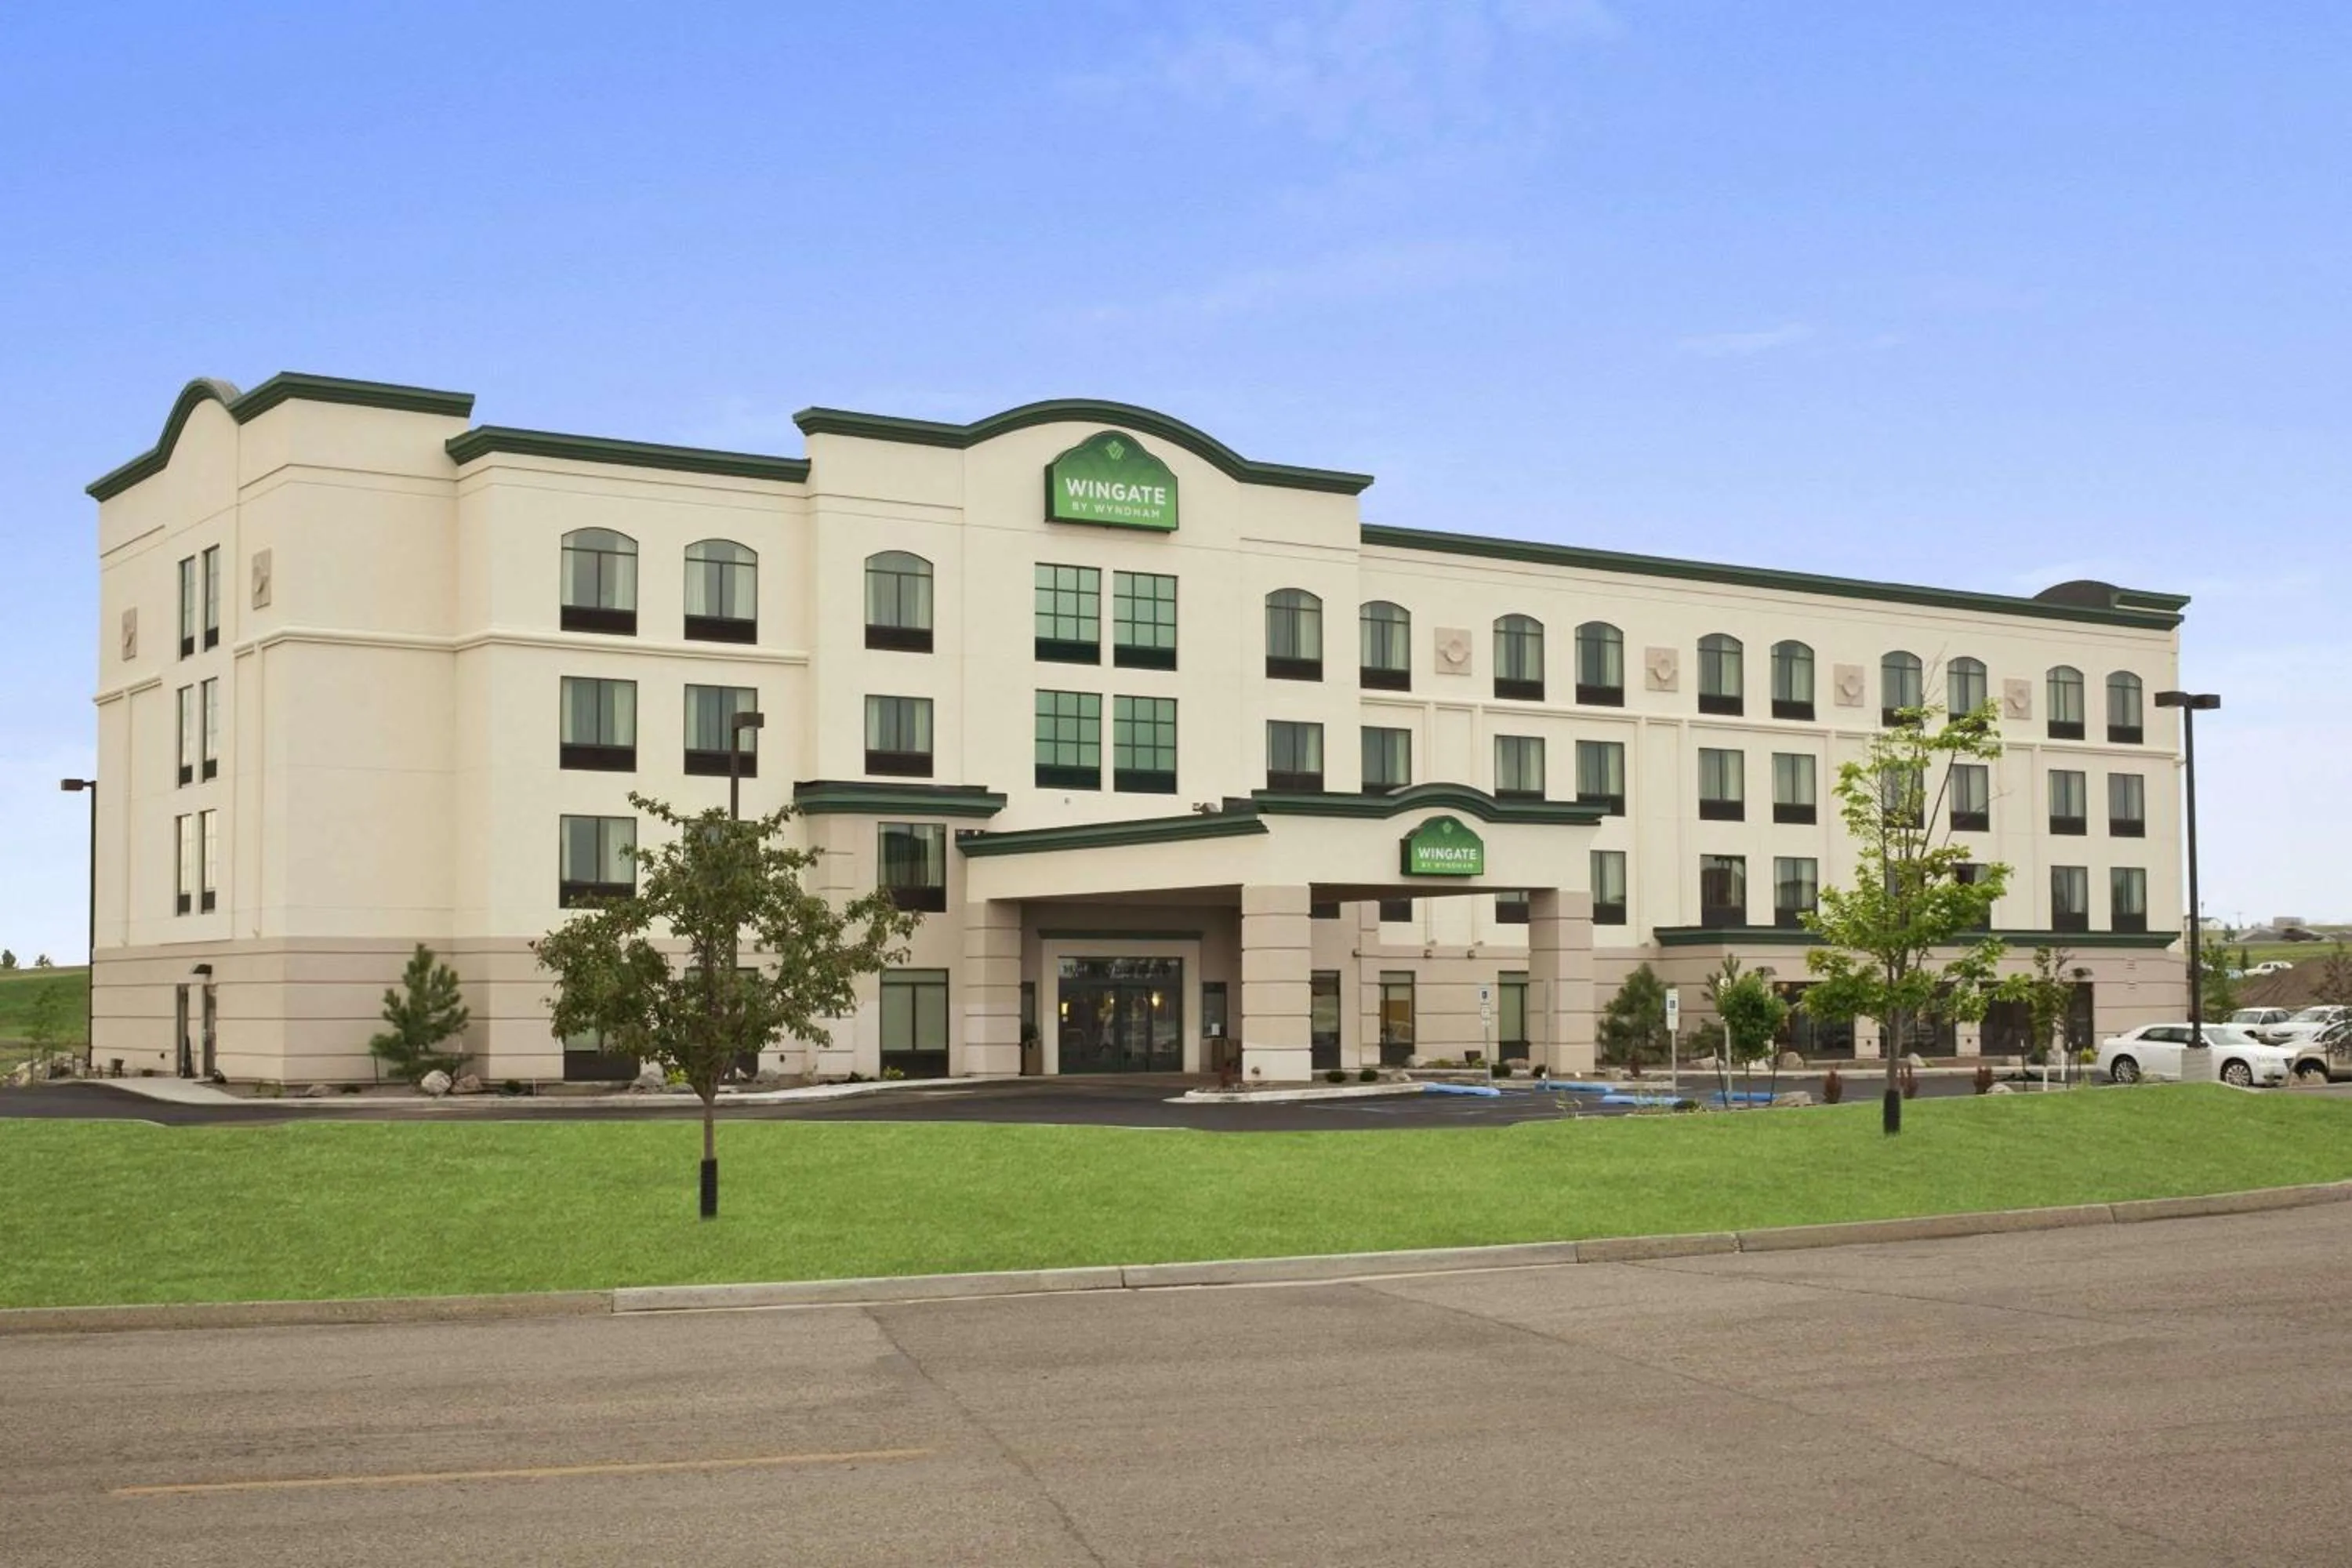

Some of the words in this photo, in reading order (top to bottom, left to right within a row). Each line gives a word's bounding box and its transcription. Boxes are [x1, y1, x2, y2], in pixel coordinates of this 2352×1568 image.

[1065, 477, 1167, 505] WINGATE
[1072, 501, 1087, 511] BY
[1094, 504, 1160, 518] WYNDHAM
[1417, 847, 1477, 860] WINGATE
